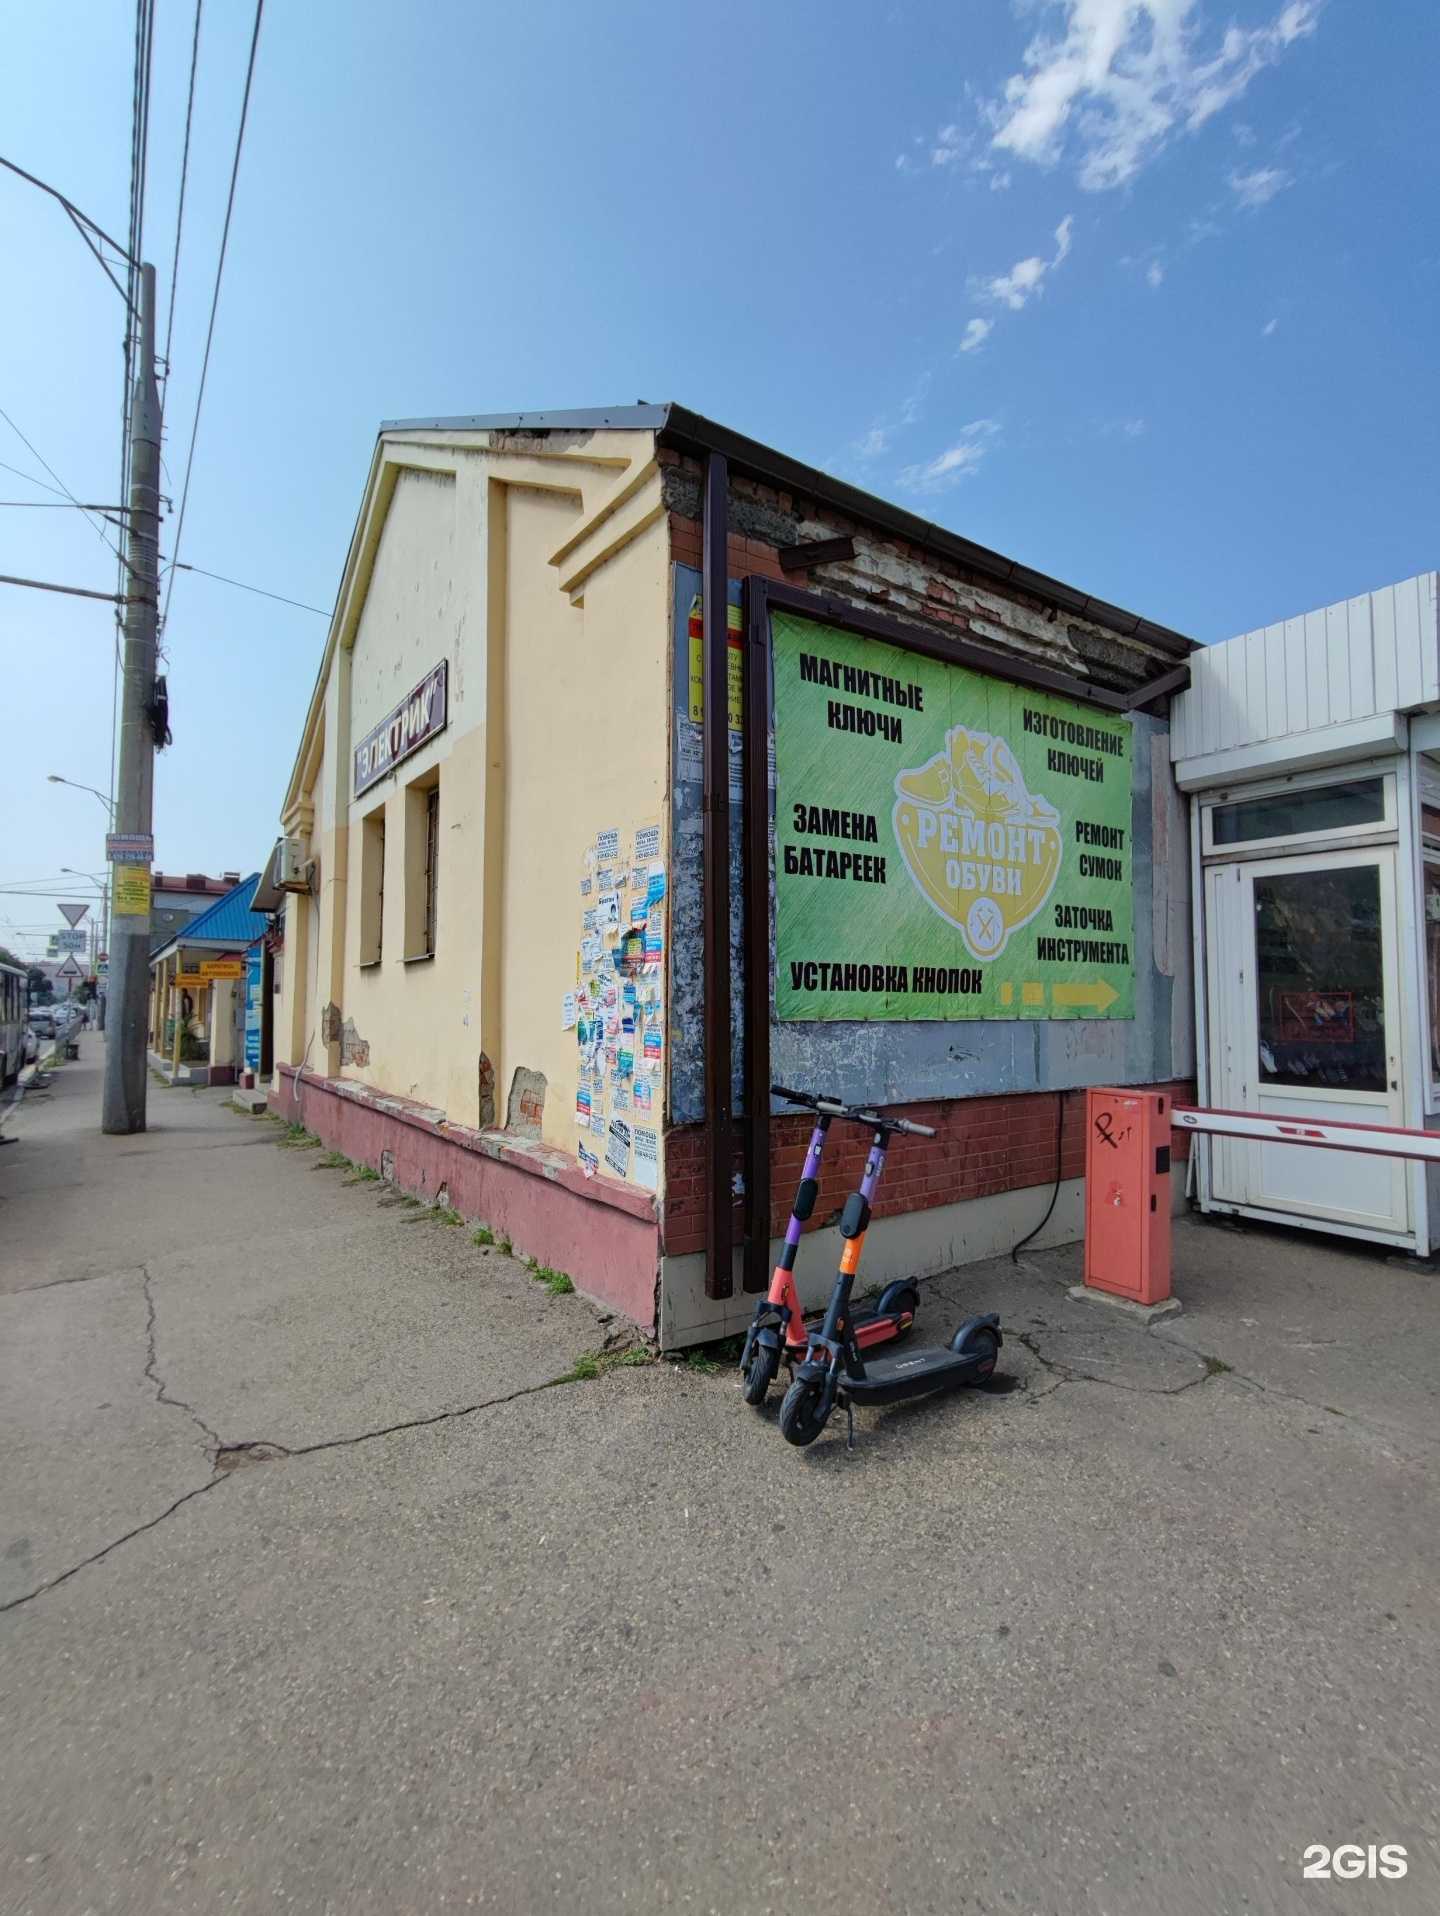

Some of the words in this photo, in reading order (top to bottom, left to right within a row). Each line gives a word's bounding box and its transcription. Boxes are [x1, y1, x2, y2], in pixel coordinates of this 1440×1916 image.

[799, 652, 924, 713] МАГНИТНЫЕ
[827, 700, 904, 744] КЛЮЧИ
[1023, 708, 1125, 758] ИЗГОТОВЛЕНИЕ
[1047, 746, 1105, 784] КЛЮЧЕЙ
[793, 803, 878, 844] ЗАМЕНА
[917, 808, 1046, 865] РЕМОНТ
[1075, 820, 1125, 850] РЕМОНТ
[783, 845, 886, 884] БАТАРЕЕК
[945, 858, 1023, 896] ОБУВИ
[1079, 853, 1123, 882] СУМОК
[1054, 904, 1113, 932] ЗАТОЧКА
[1037, 936, 1130, 965] ИНСТРУМЕНТА
[790, 961, 909, 993] УСТАНОВКА
[911, 966, 983, 994] КНОПОК
